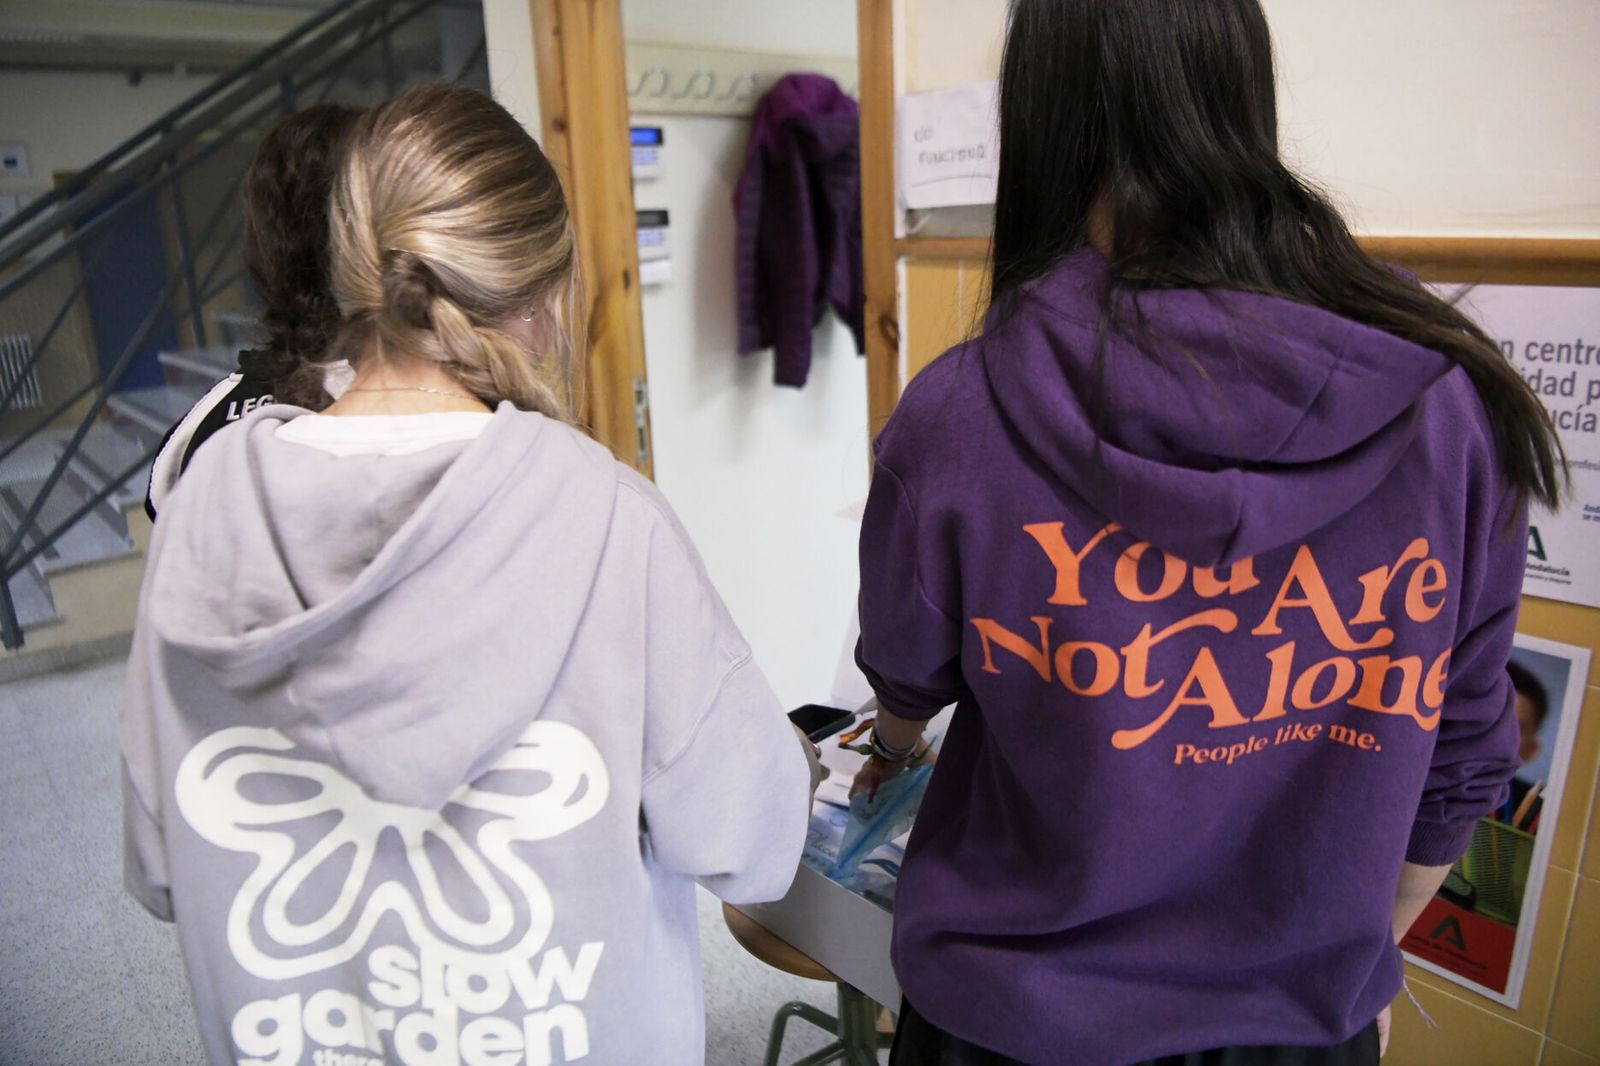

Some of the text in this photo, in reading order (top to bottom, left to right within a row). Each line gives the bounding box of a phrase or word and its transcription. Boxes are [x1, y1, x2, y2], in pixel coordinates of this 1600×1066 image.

[1500, 340, 1514, 361] n
[226, 394, 274, 421] LEG
[1521, 367, 1600, 406] idad p
[1022, 521, 1448, 651] You Are
[969, 608, 1452, 749] Not Alone
[1173, 723, 1382, 765] People like me.
[368, 941, 605, 1014] slow
[231, 988, 590, 1066] garden
